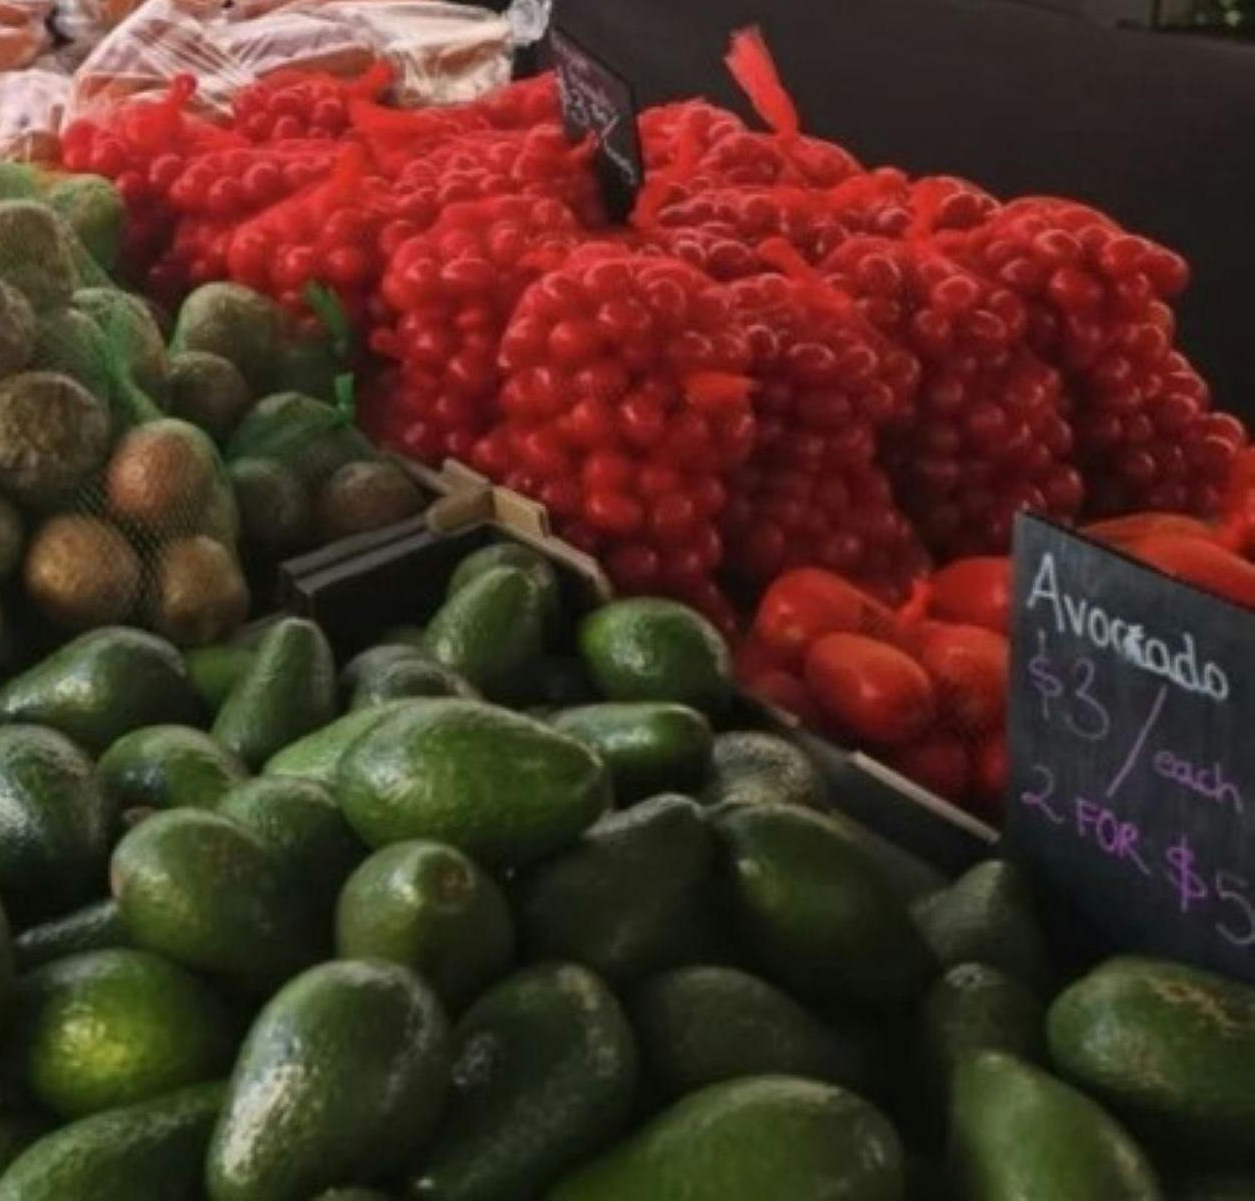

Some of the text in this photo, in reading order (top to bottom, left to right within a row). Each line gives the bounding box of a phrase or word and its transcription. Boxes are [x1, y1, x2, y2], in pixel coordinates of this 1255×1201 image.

[1020, 764, 1255, 946] 2 FOR $5
